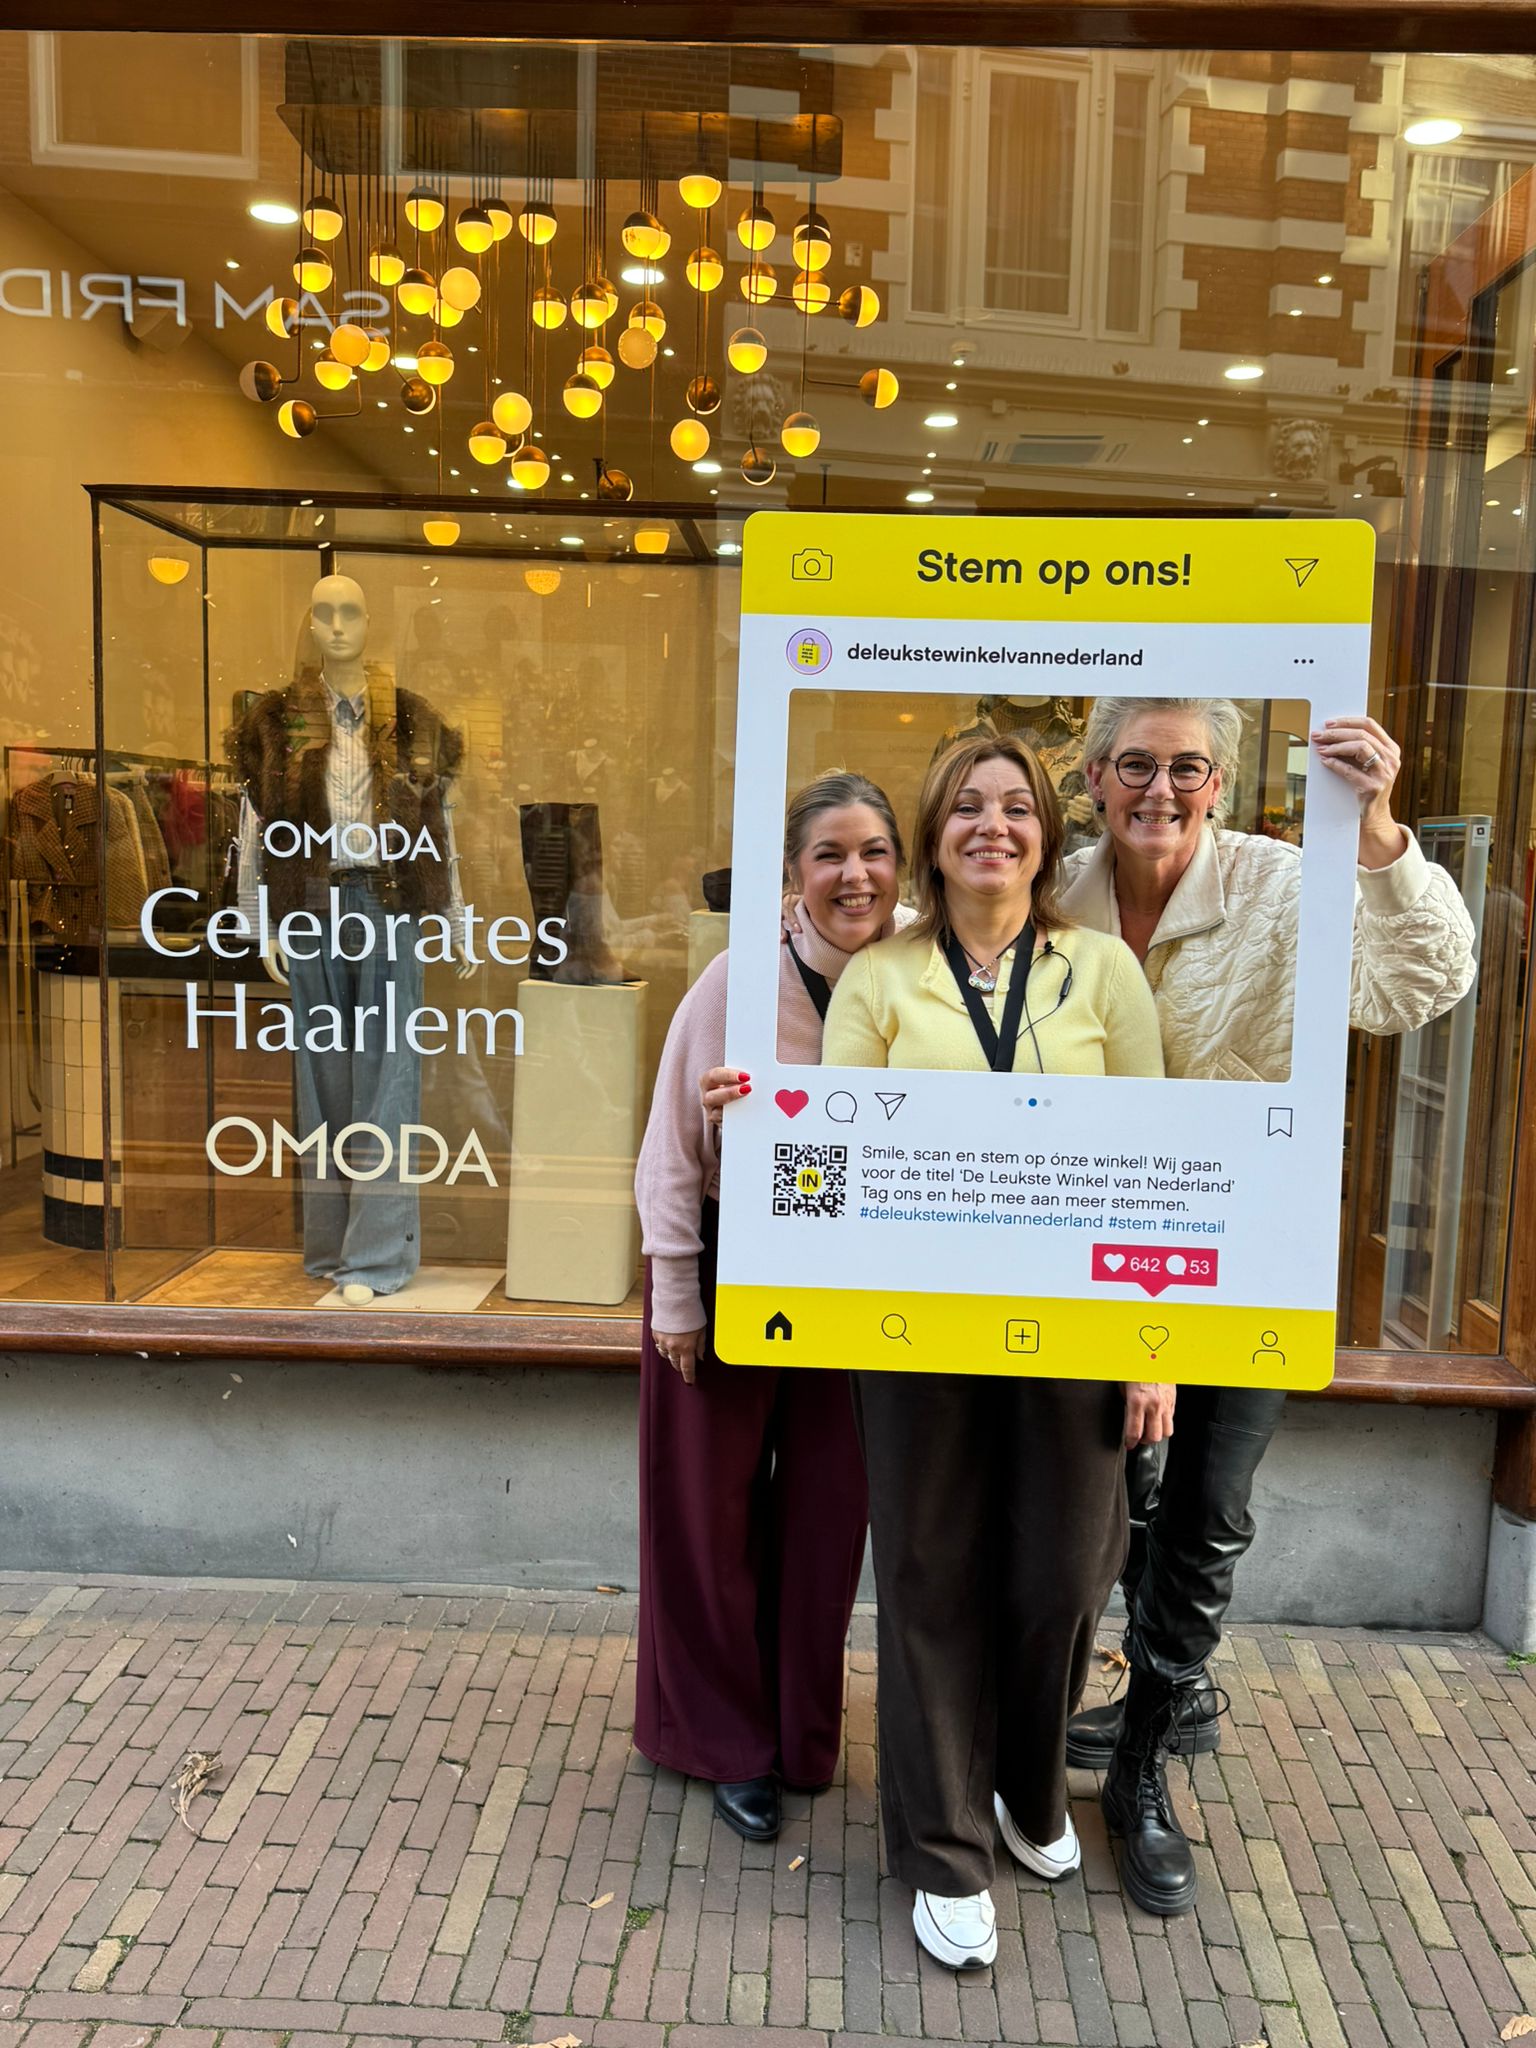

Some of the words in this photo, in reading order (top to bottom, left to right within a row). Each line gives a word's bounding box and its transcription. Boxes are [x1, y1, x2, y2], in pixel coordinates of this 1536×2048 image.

[917, 549, 1022, 584] Stem
[1038, 559, 1090, 595] op
[1105, 553, 1191, 586] ons!
[847, 642, 1143, 667] deleukstewinkelvannederland
[264, 820, 442, 862] OMODA
[140, 886, 568, 966] Celebrates
[186, 981, 525, 1056] Haarlem
[205, 1116, 499, 1187] OMODA
[862, 1145, 908, 1163] Smile,
[913, 1150, 951, 1162] scan
[955, 1151, 976, 1163] en
[980, 1151, 1019, 1164] stem
[1024, 1154, 1046, 1169] op
[1050, 1152, 1089, 1167] ónze
[1093, 1154, 1148, 1169] winkel!
[1152, 1156, 1177, 1175] Wij
[1181, 1160, 1222, 1176] gaan
[801, 1174, 819, 1189] IN
[861, 1168, 896, 1180] voor
[900, 1166, 921, 1181] de
[926, 1168, 955, 1182] titel
[989, 1170, 1052, 1186] Leukste
[1056, 1173, 1109, 1188] Winkel
[1113, 1178, 1141, 1189] van
[861, 1186, 889, 1204] Tag
[893, 1189, 922, 1201] ons
[926, 1190, 947, 1202] en
[951, 1188, 986, 1207] help
[991, 1193, 1026, 1205] mee
[1030, 1194, 1060, 1206] aan
[1065, 1196, 1107, 1208] meer
[1111, 1197, 1189, 1213] stemmen.
[859, 1205, 1103, 1229] #deleukstewinkelvannederland
[1108, 1216, 1157, 1232] #stem
[1162, 1218, 1225, 1235] #inretail
[1130, 1257, 1160, 1272] 642
[1189, 1260, 1210, 1275] 53
